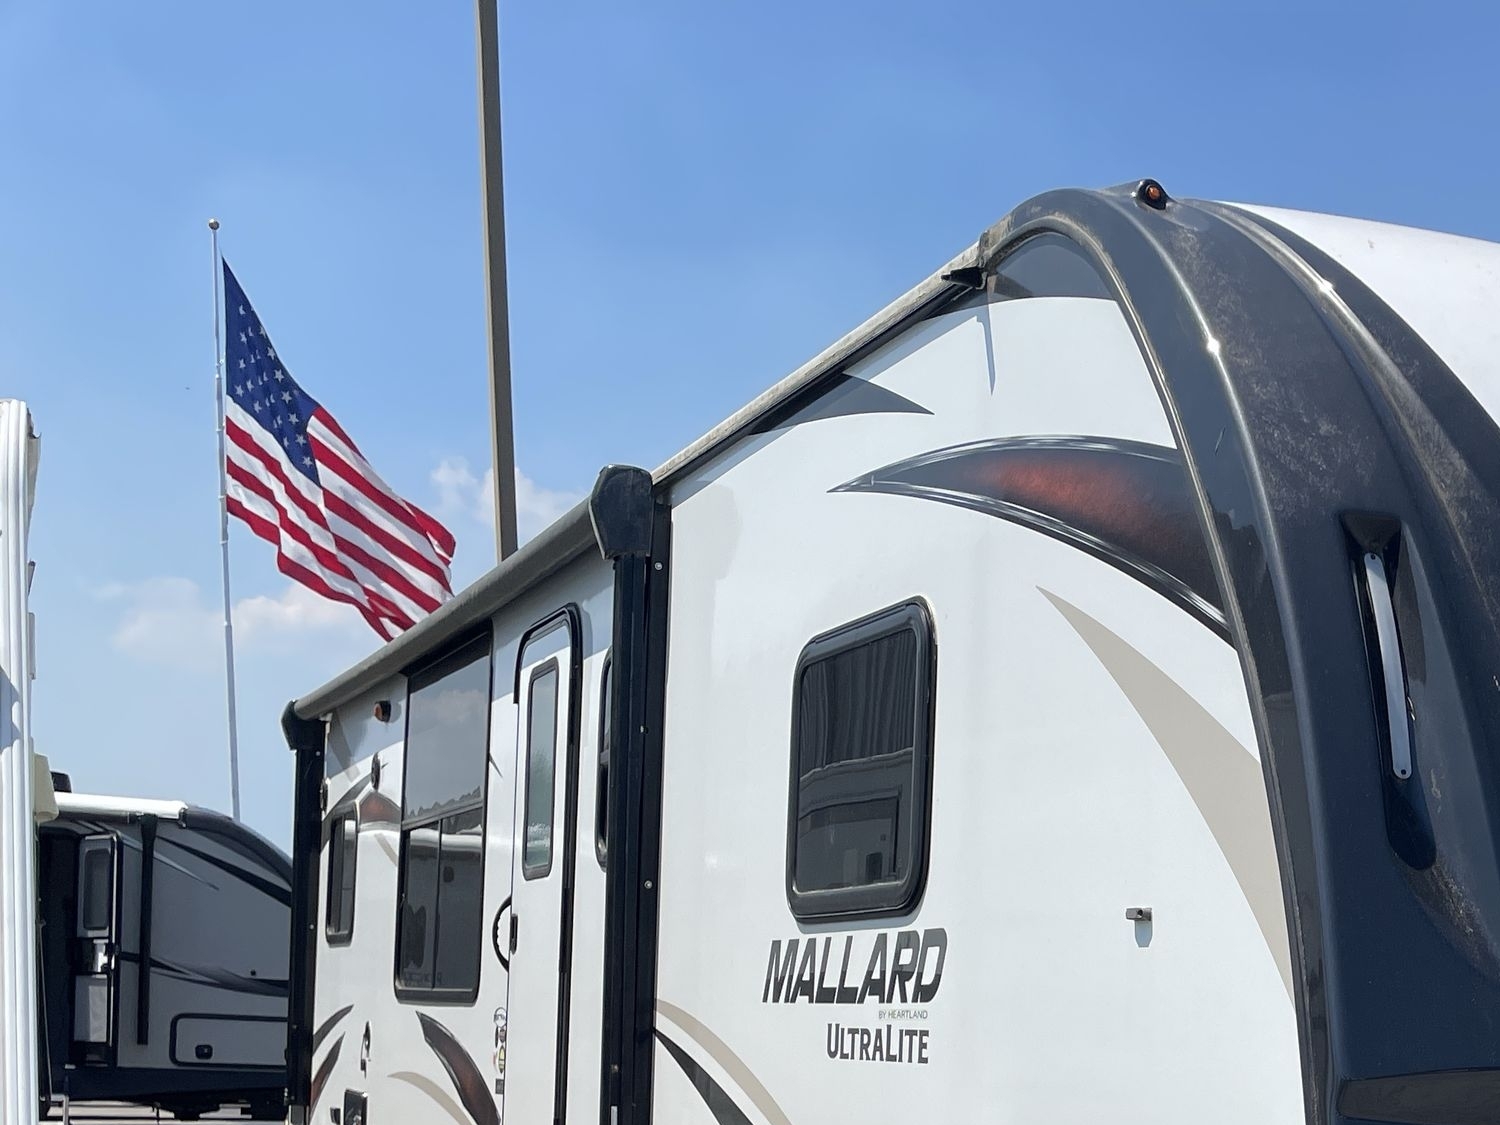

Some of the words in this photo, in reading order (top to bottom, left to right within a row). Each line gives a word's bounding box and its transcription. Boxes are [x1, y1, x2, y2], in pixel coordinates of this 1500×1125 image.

[762, 927, 948, 1004] MALLARD
[878, 1010, 887, 1019] BY
[888, 1010, 928, 1020] HEARTLAND
